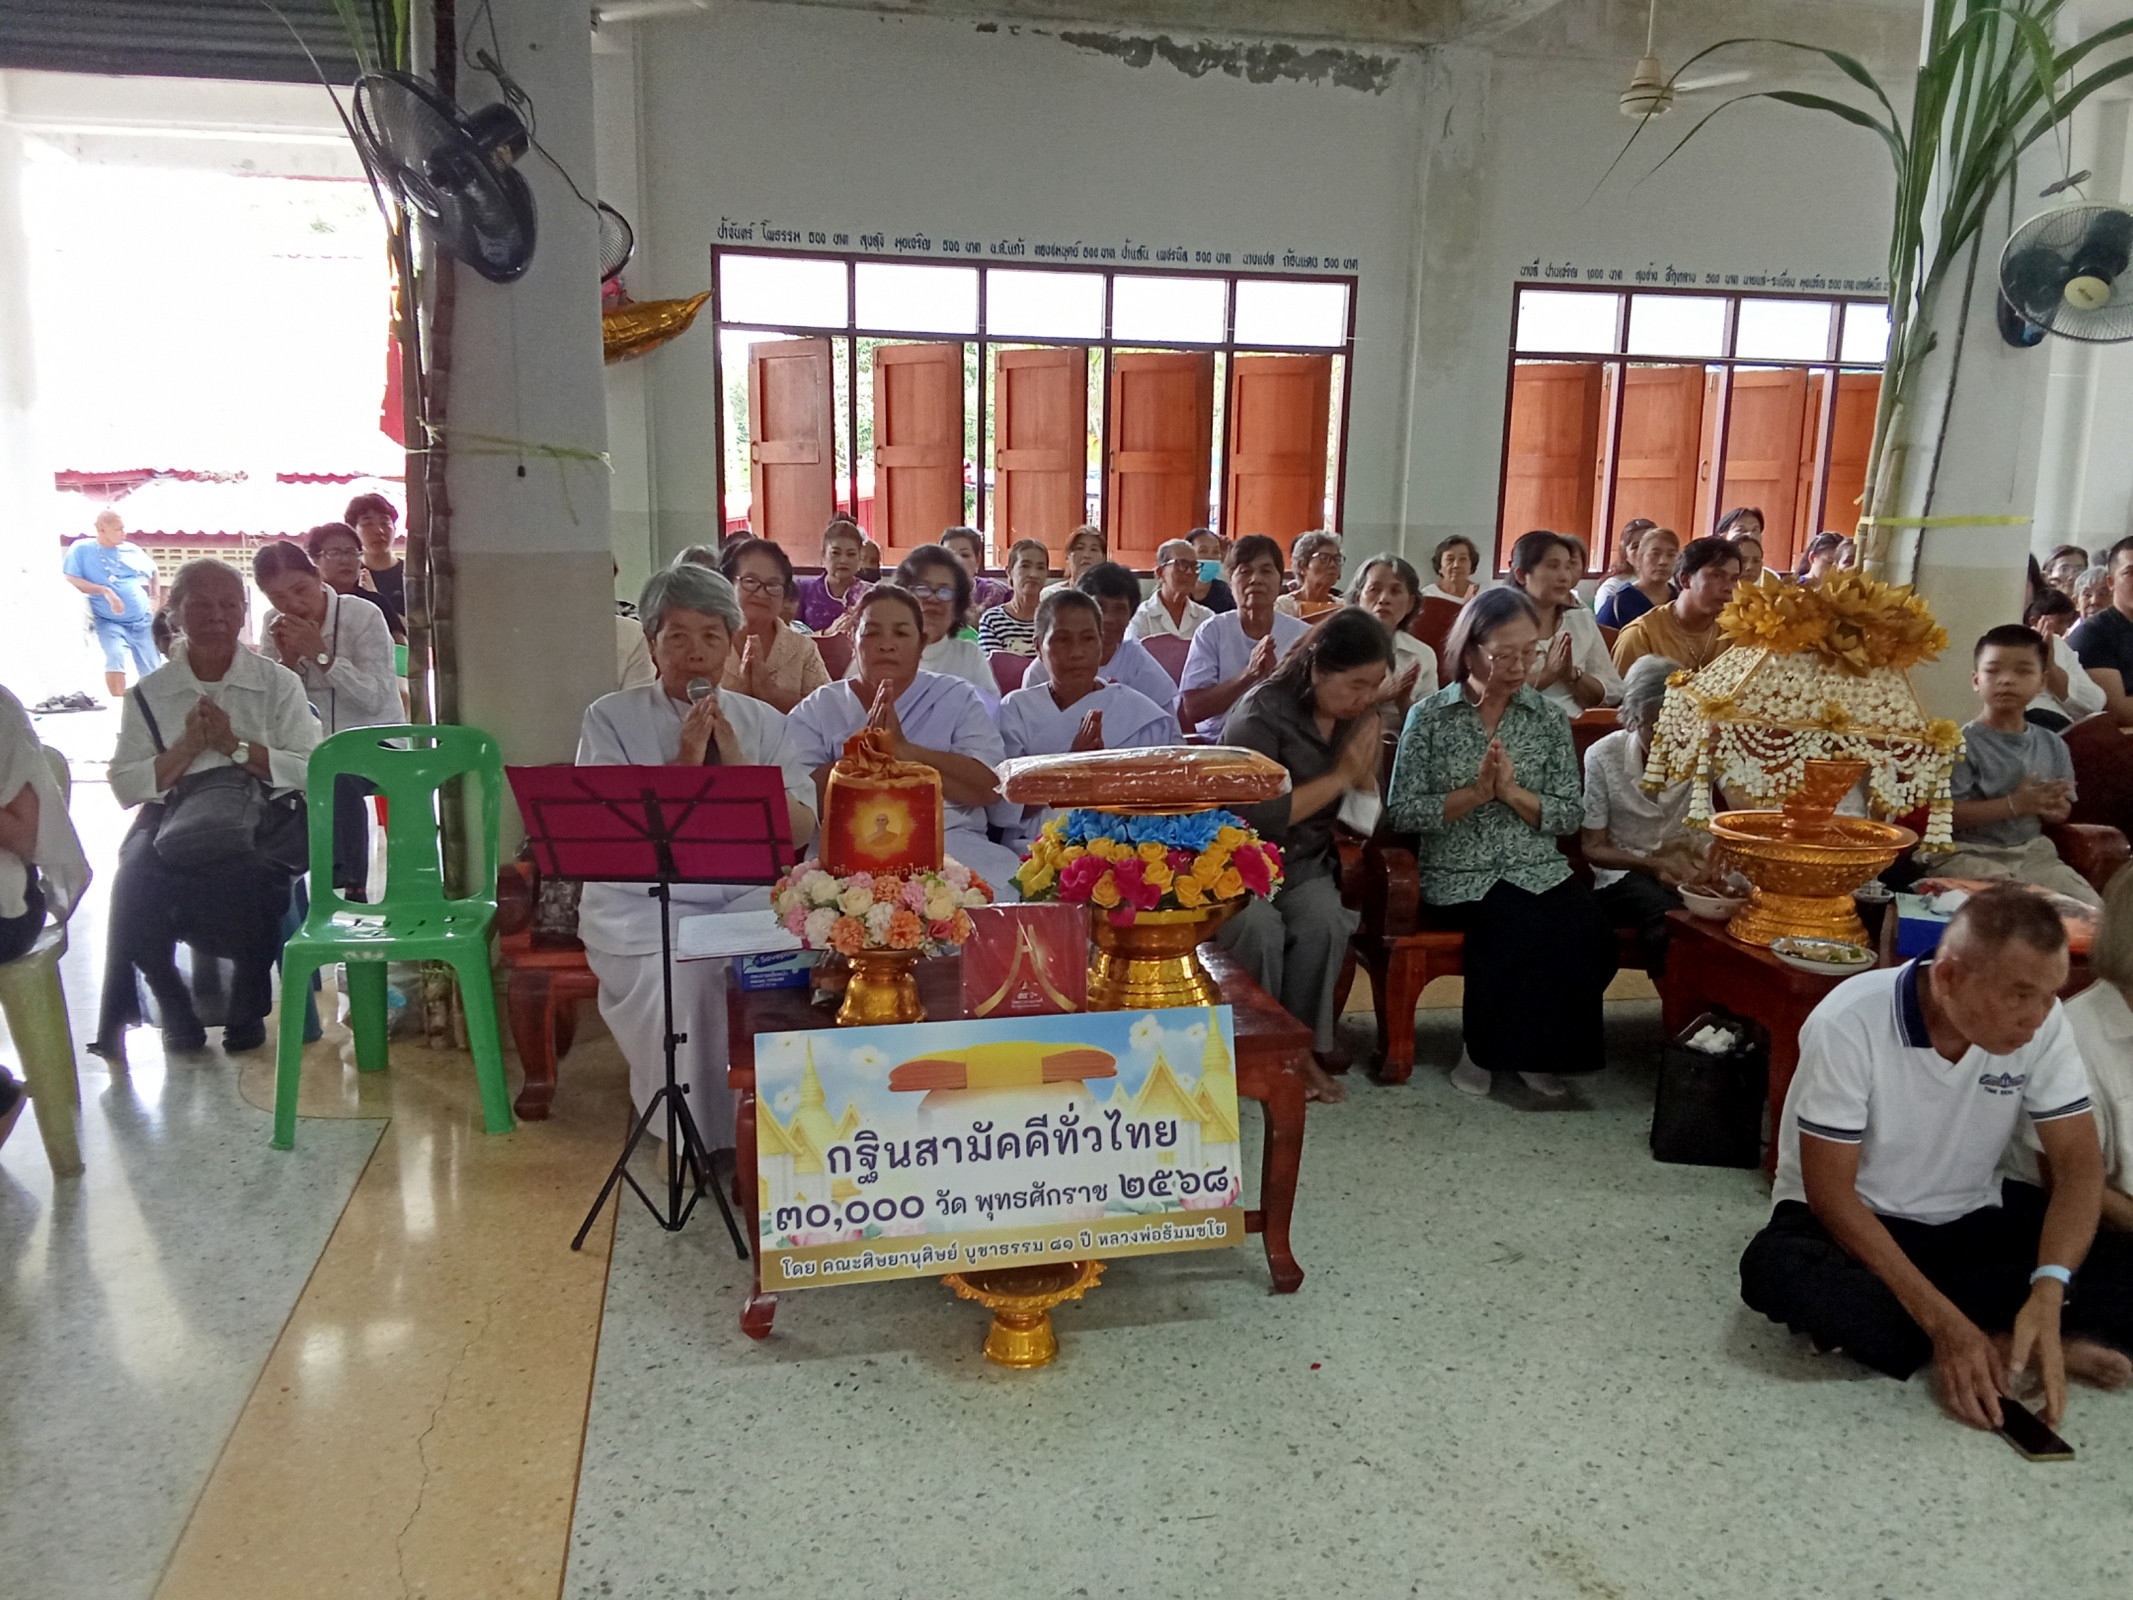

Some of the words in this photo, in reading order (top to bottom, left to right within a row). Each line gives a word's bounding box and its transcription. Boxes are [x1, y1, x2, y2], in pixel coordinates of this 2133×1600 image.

[833, 233, 849, 246] บาท
[965, 241, 981, 254] บาท
[1100, 247, 1116, 259] บาท
[1216, 252, 1232, 264] บาท
[1343, 258, 1359, 270] บาท
[827, 1102, 1177, 1184] กฐินสามัคคีทั่วไทย
[776, 1195, 925, 1232] ๓๐,๐๐๐
[936, 1189, 967, 1216] วัด
[975, 1181, 1108, 1222] พุทธศักราช
[1118, 1166, 1229, 1199] ๒๕๖๘
[782, 1259, 816, 1277] โดย
[823, 1243, 958, 1273] คณะศิษยานุศิษย์
[965, 1239, 1043, 1264] บูชาธรรม
[1050, 1238, 1074, 1251] ๘๑
[1080, 1231, 1091, 1247] ปี
[1098, 1219, 1226, 1247] หลวงพ่อธัมมชโย
